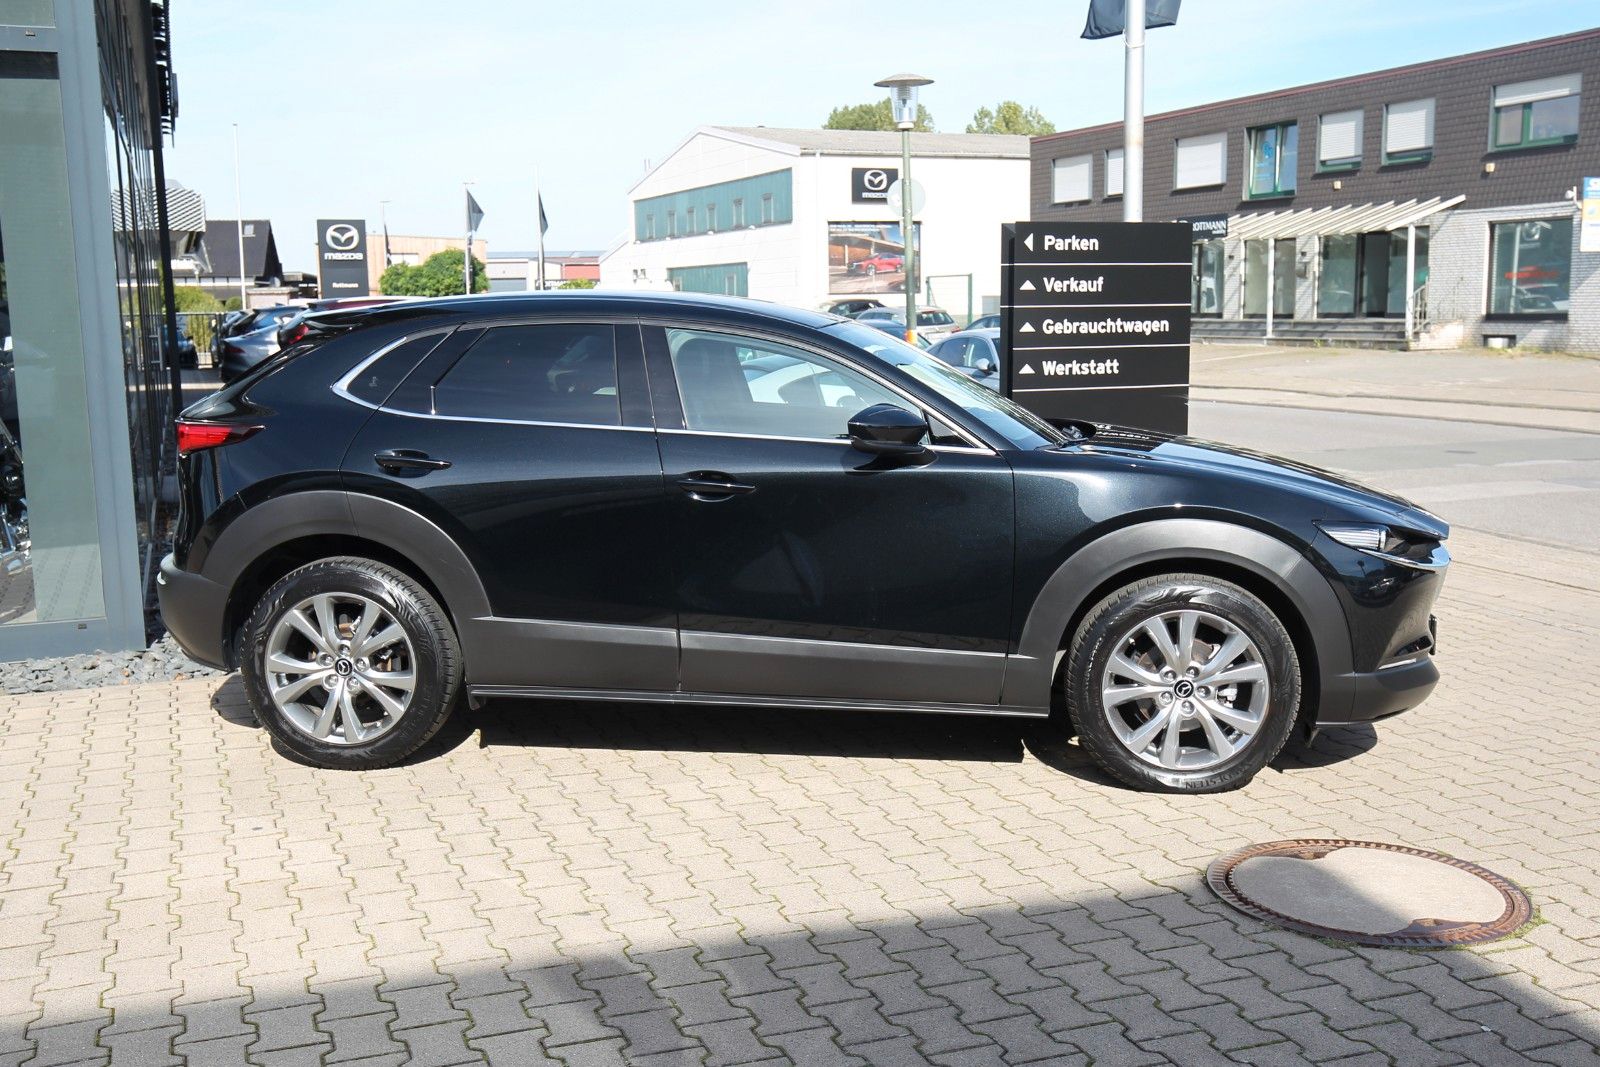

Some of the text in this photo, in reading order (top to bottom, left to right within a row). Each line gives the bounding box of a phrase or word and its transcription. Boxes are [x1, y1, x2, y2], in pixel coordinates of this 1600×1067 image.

[1044, 235, 1099, 251] Parken
[1043, 276, 1104, 292] Verkauf
[1042, 318, 1169, 335] Gebrauchtwagen
[1042, 359, 1119, 375] Werkstatt
